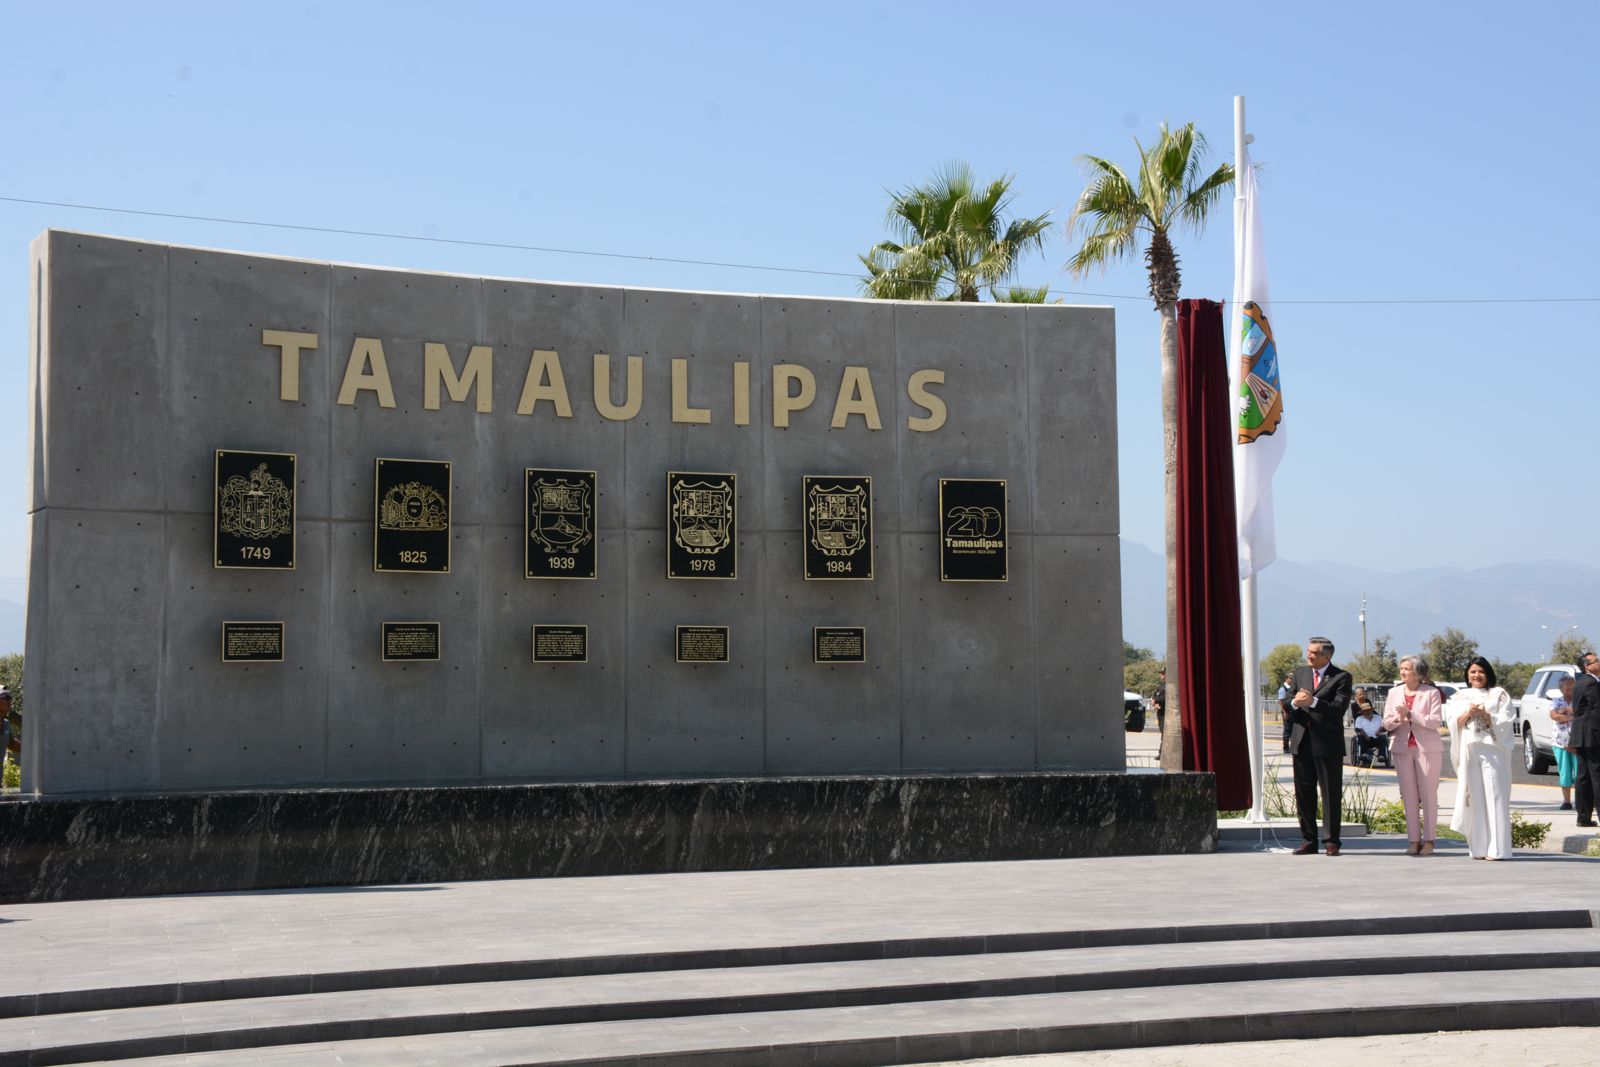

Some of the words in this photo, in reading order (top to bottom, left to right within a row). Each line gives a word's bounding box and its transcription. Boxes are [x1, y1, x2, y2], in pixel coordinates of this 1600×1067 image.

[262, 329, 947, 432] TAMAULIPAS
[945, 538, 1004, 550] Tamaulipas
[240, 546, 271, 560] 1749
[398, 550, 428, 564] 1825
[548, 557, 575, 569] 1939
[689, 559, 716, 571] 1978
[826, 561, 852, 573] 1984
